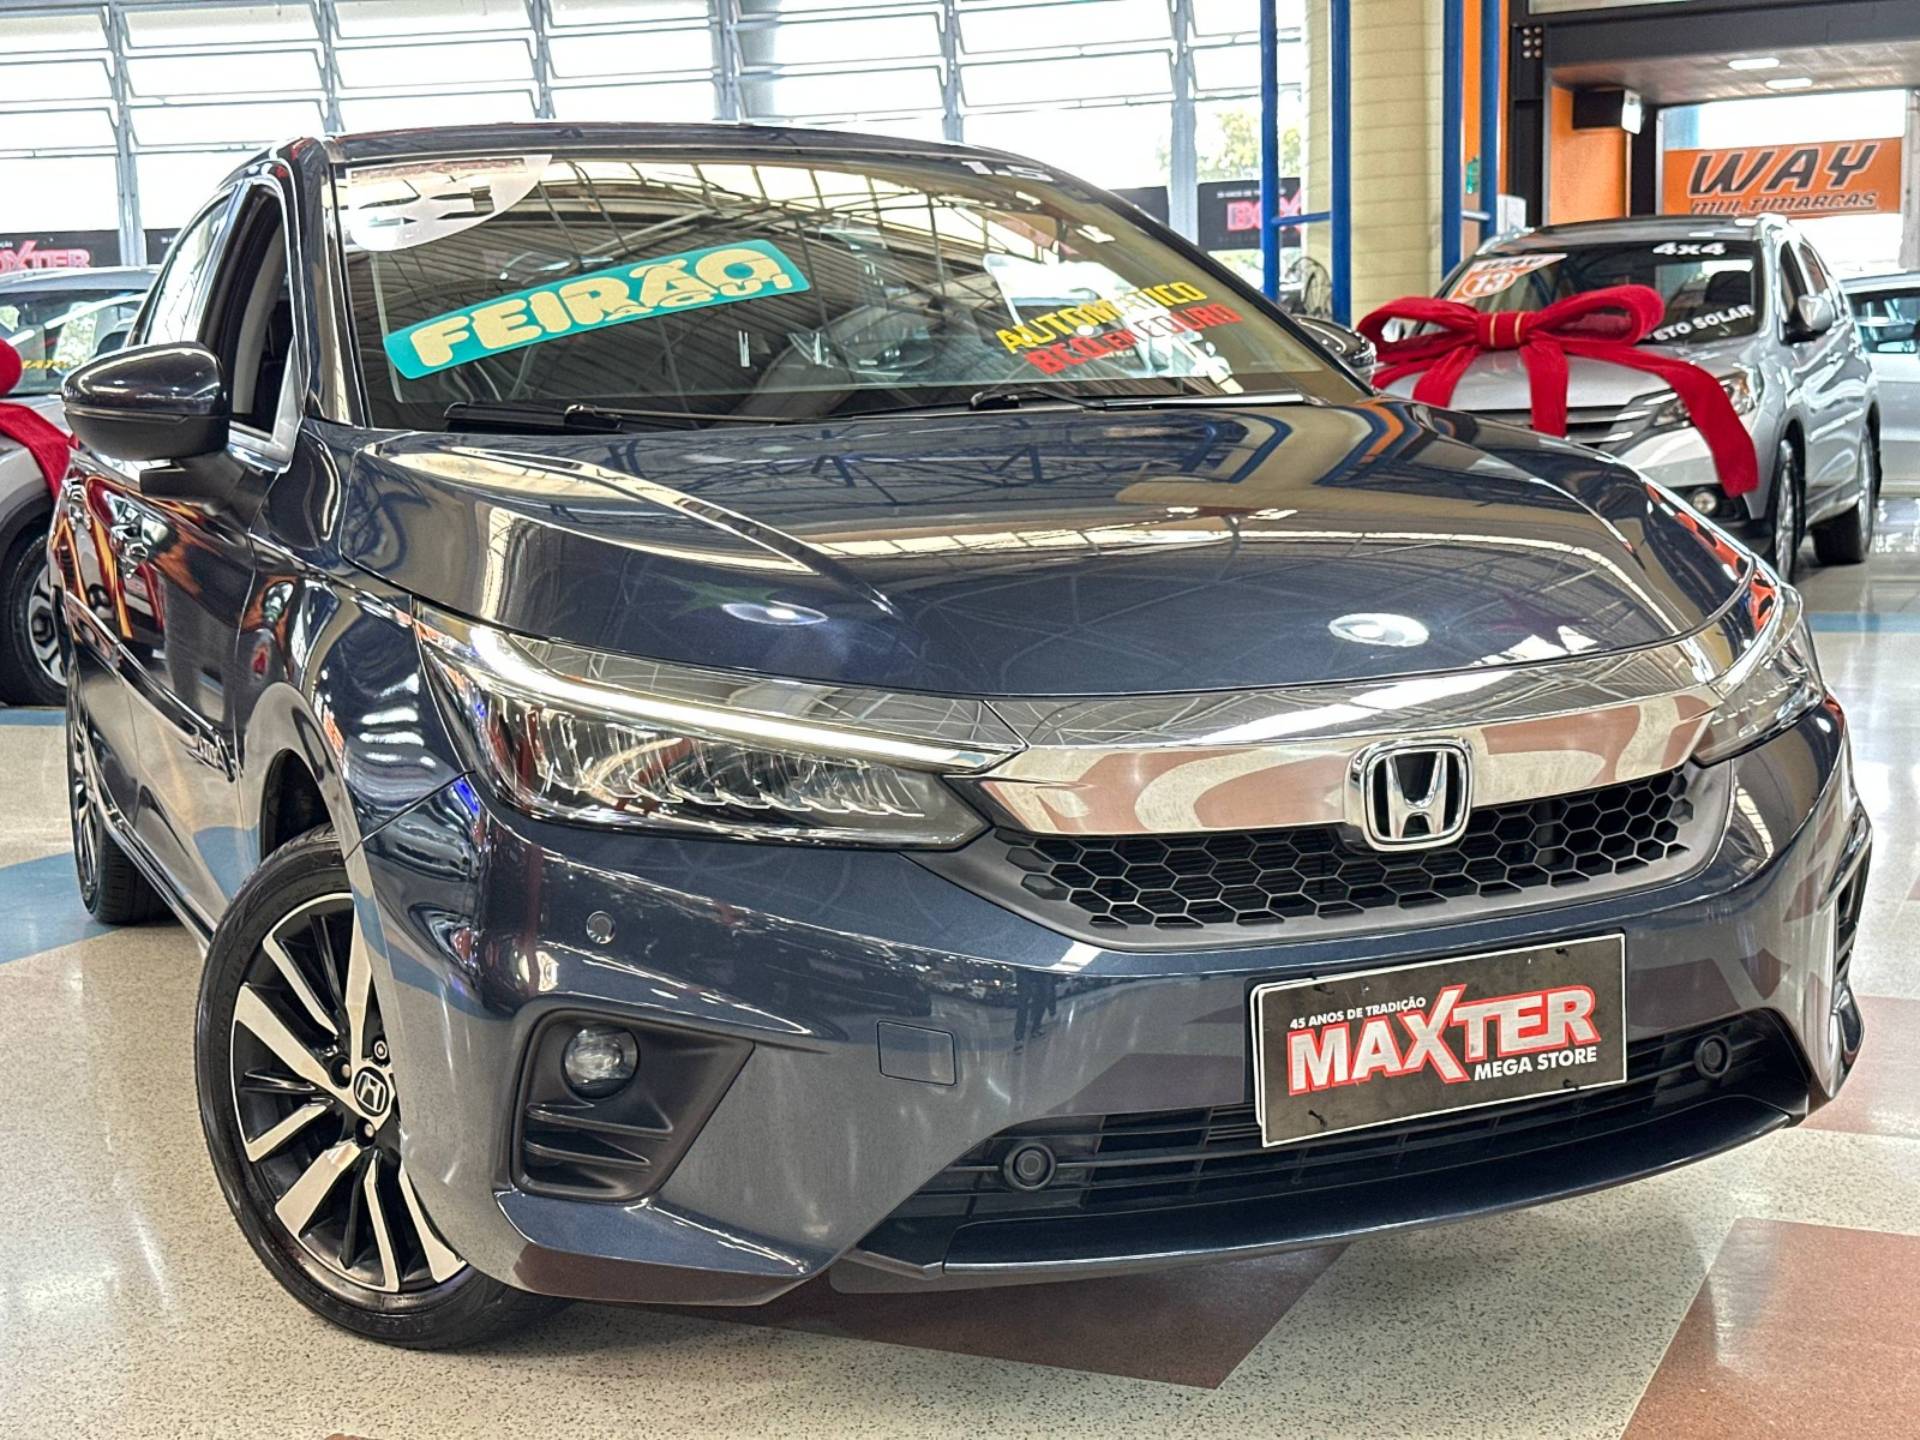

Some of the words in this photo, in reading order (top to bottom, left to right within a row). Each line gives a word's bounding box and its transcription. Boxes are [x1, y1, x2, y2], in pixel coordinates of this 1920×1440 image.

[1688, 142, 1880, 198] WAY
[409, 248, 783, 367] FEIRÃO
[1647, 321, 1692, 340] ETO
[1692, 304, 1755, 329] SOLAR
[1290, 1016, 1306, 1029] 45
[1308, 1010, 1345, 1026] ANOS
[1347, 1007, 1364, 1020] DE
[1366, 996, 1426, 1016] TRADIÇÃO
[1287, 984, 1601, 1096] MAXTER
[1474, 1056, 1533, 1082] MEGA
[1536, 1046, 1597, 1070] STORE
